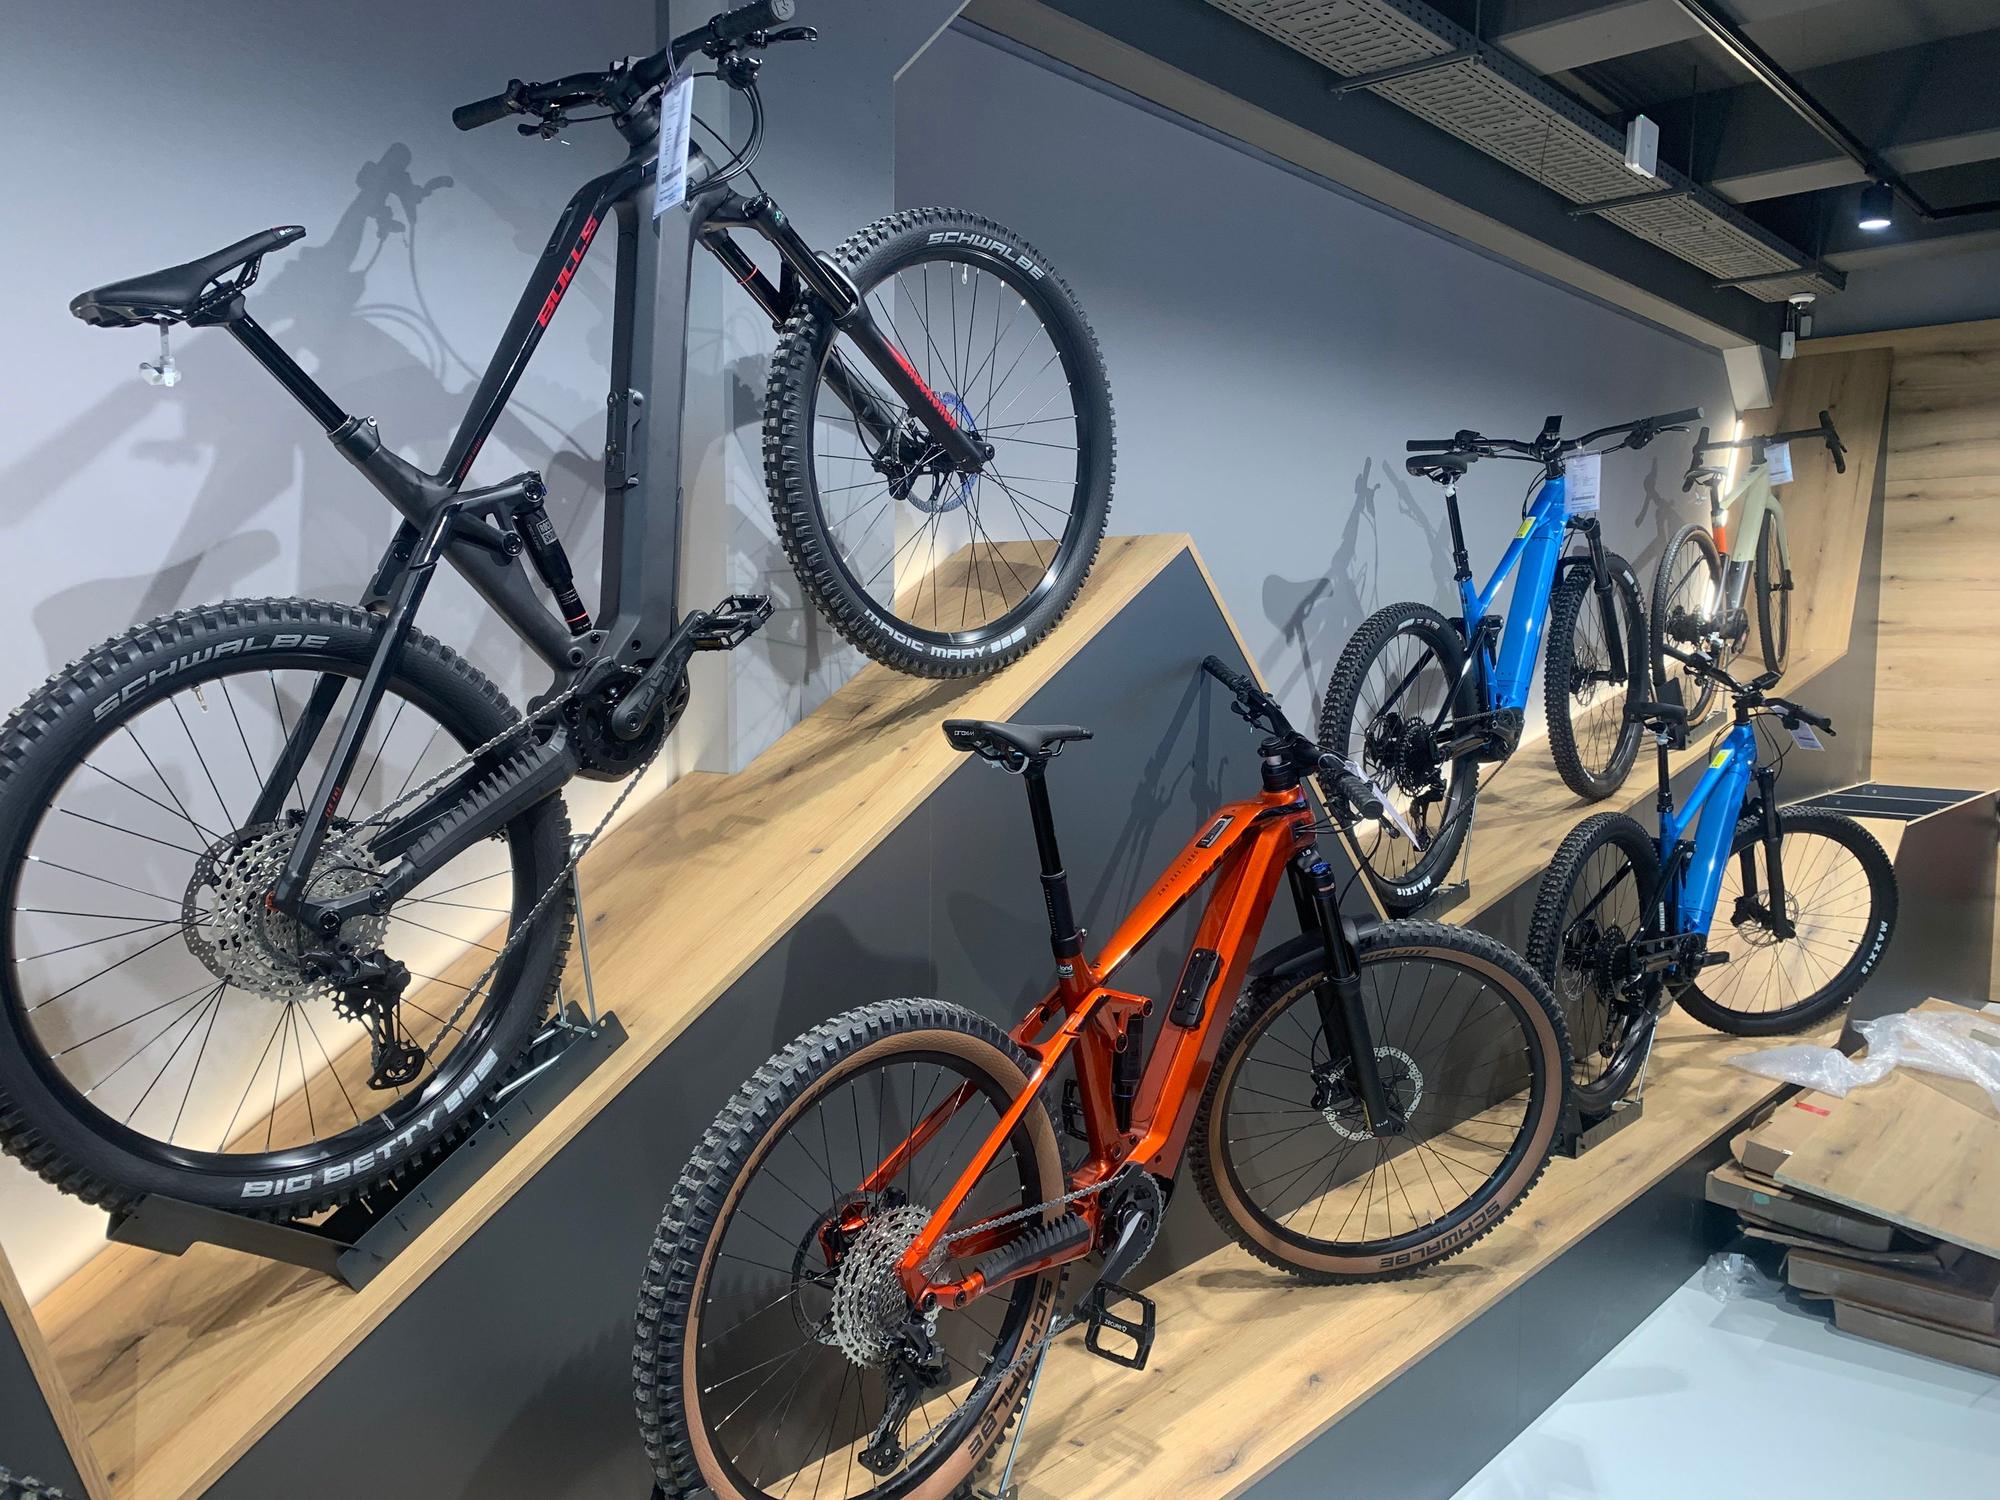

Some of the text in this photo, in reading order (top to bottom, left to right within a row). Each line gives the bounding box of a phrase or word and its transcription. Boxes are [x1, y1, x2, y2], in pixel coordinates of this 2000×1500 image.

[538, 214, 599, 328] BULLS
[926, 231, 1046, 281] SCHWALBE
[863, 608, 986, 662] MAGIC MARY
[92, 634, 331, 723] SCHWALBE
[1396, 875, 1432, 897] MAXXIS
[1861, 920, 1888, 974] MAXXIS
[240, 1107, 438, 1198] BIG BETTY
[1380, 1200, 1501, 1268] SCHWALBE
